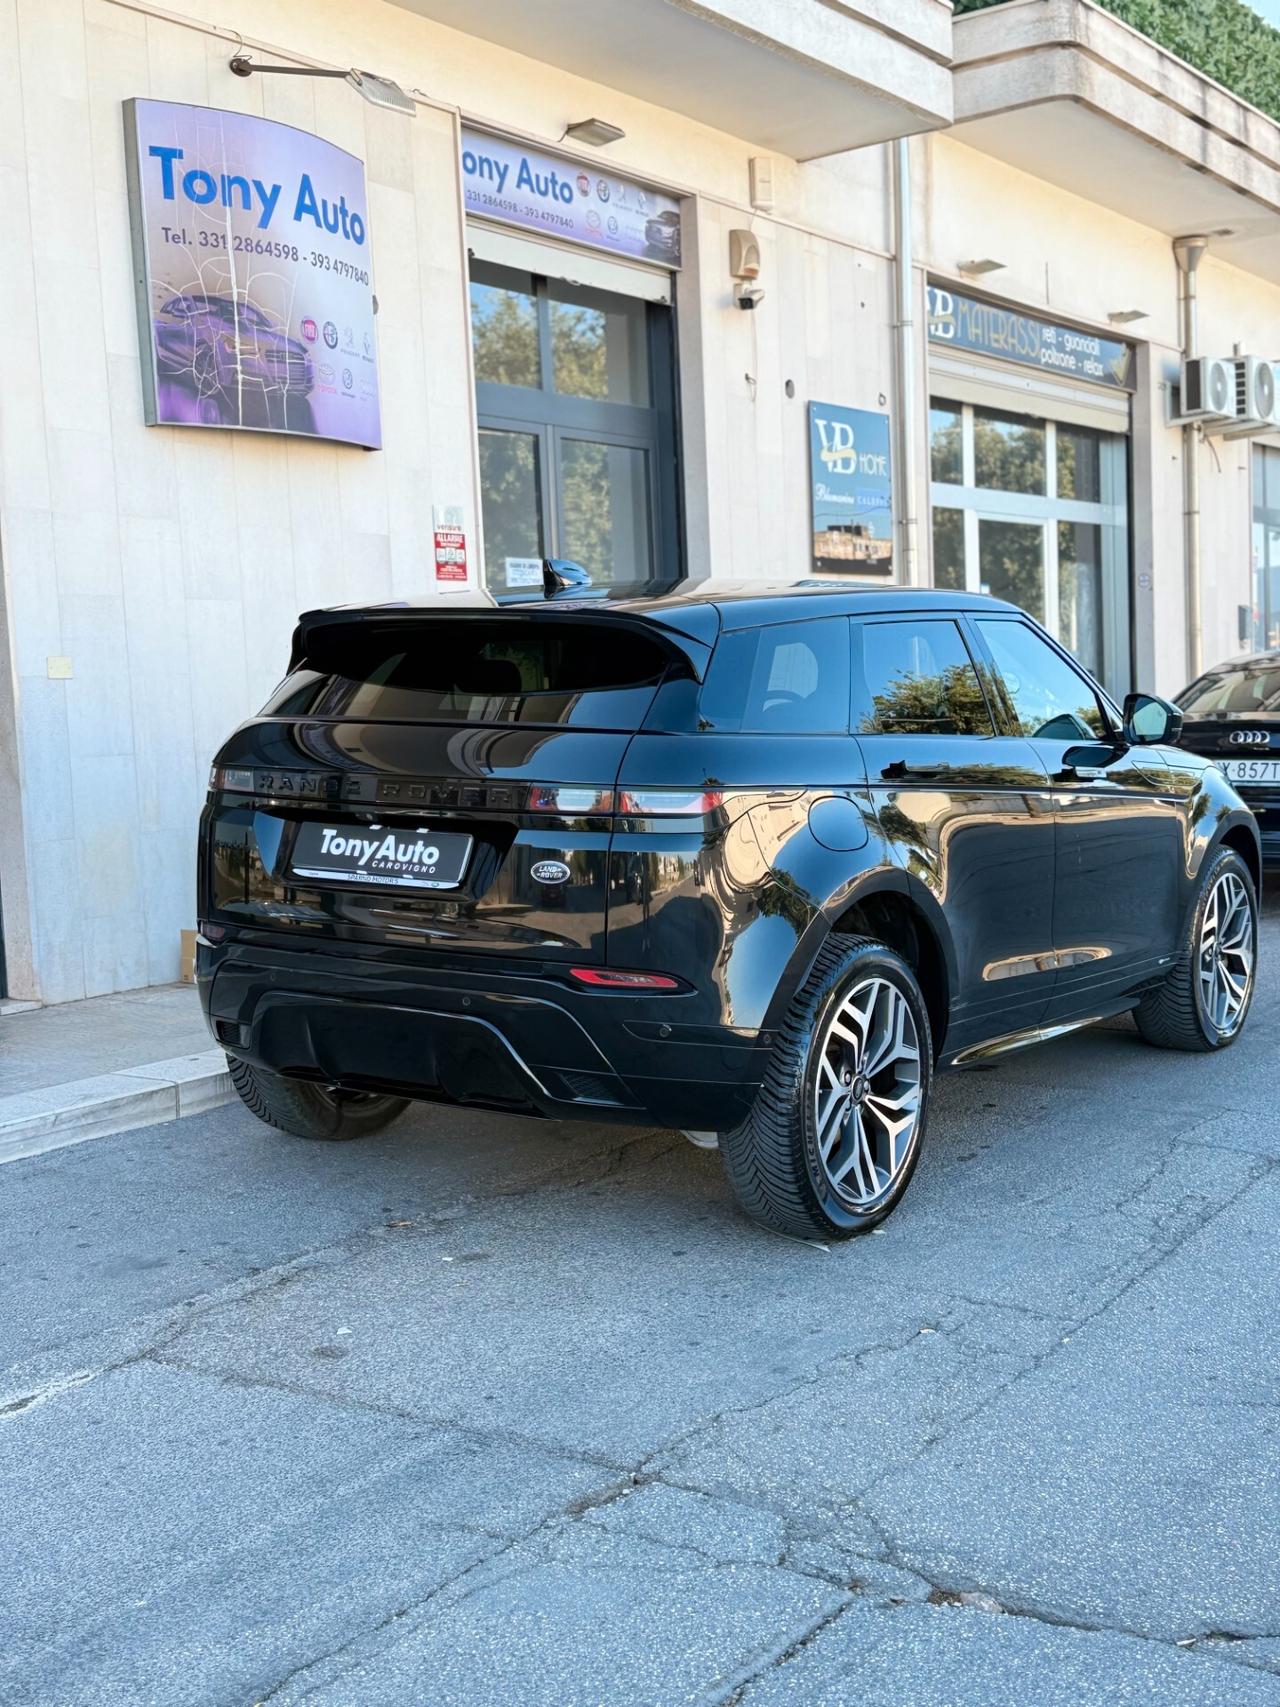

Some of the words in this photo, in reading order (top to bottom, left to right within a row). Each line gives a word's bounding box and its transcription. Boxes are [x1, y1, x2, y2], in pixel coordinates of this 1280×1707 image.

[462, 150, 509, 193] ony
[516, 158, 574, 204] Auto
[149, 145, 282, 229] Tony
[293, 173, 365, 246] Auto
[467, 190, 481, 203] 331
[482, 192, 518, 213] 2864598
[524, 206, 540, 220] 393
[540, 211, 574, 230] 4797840
[162, 227, 193, 246] Tel.
[199, 231, 228, 248] 331
[234, 235, 299, 262] 2864598
[310, 252, 331, 272] 393
[333, 254, 369, 287] 4797840
[957, 297, 1041, 358] MATERASSI
[1040, 345, 1077, 370] poltrone
[1083, 356, 1104, 377] relax
[859, 452, 888, 477] HOME
[260, 774, 361, 797] RANGE
[383, 783, 512, 804] ROVER
[371, 859, 436, 875] CAROVIGNO
[539, 865, 558, 873] LAND
[540, 871, 563, 879] ROVER
